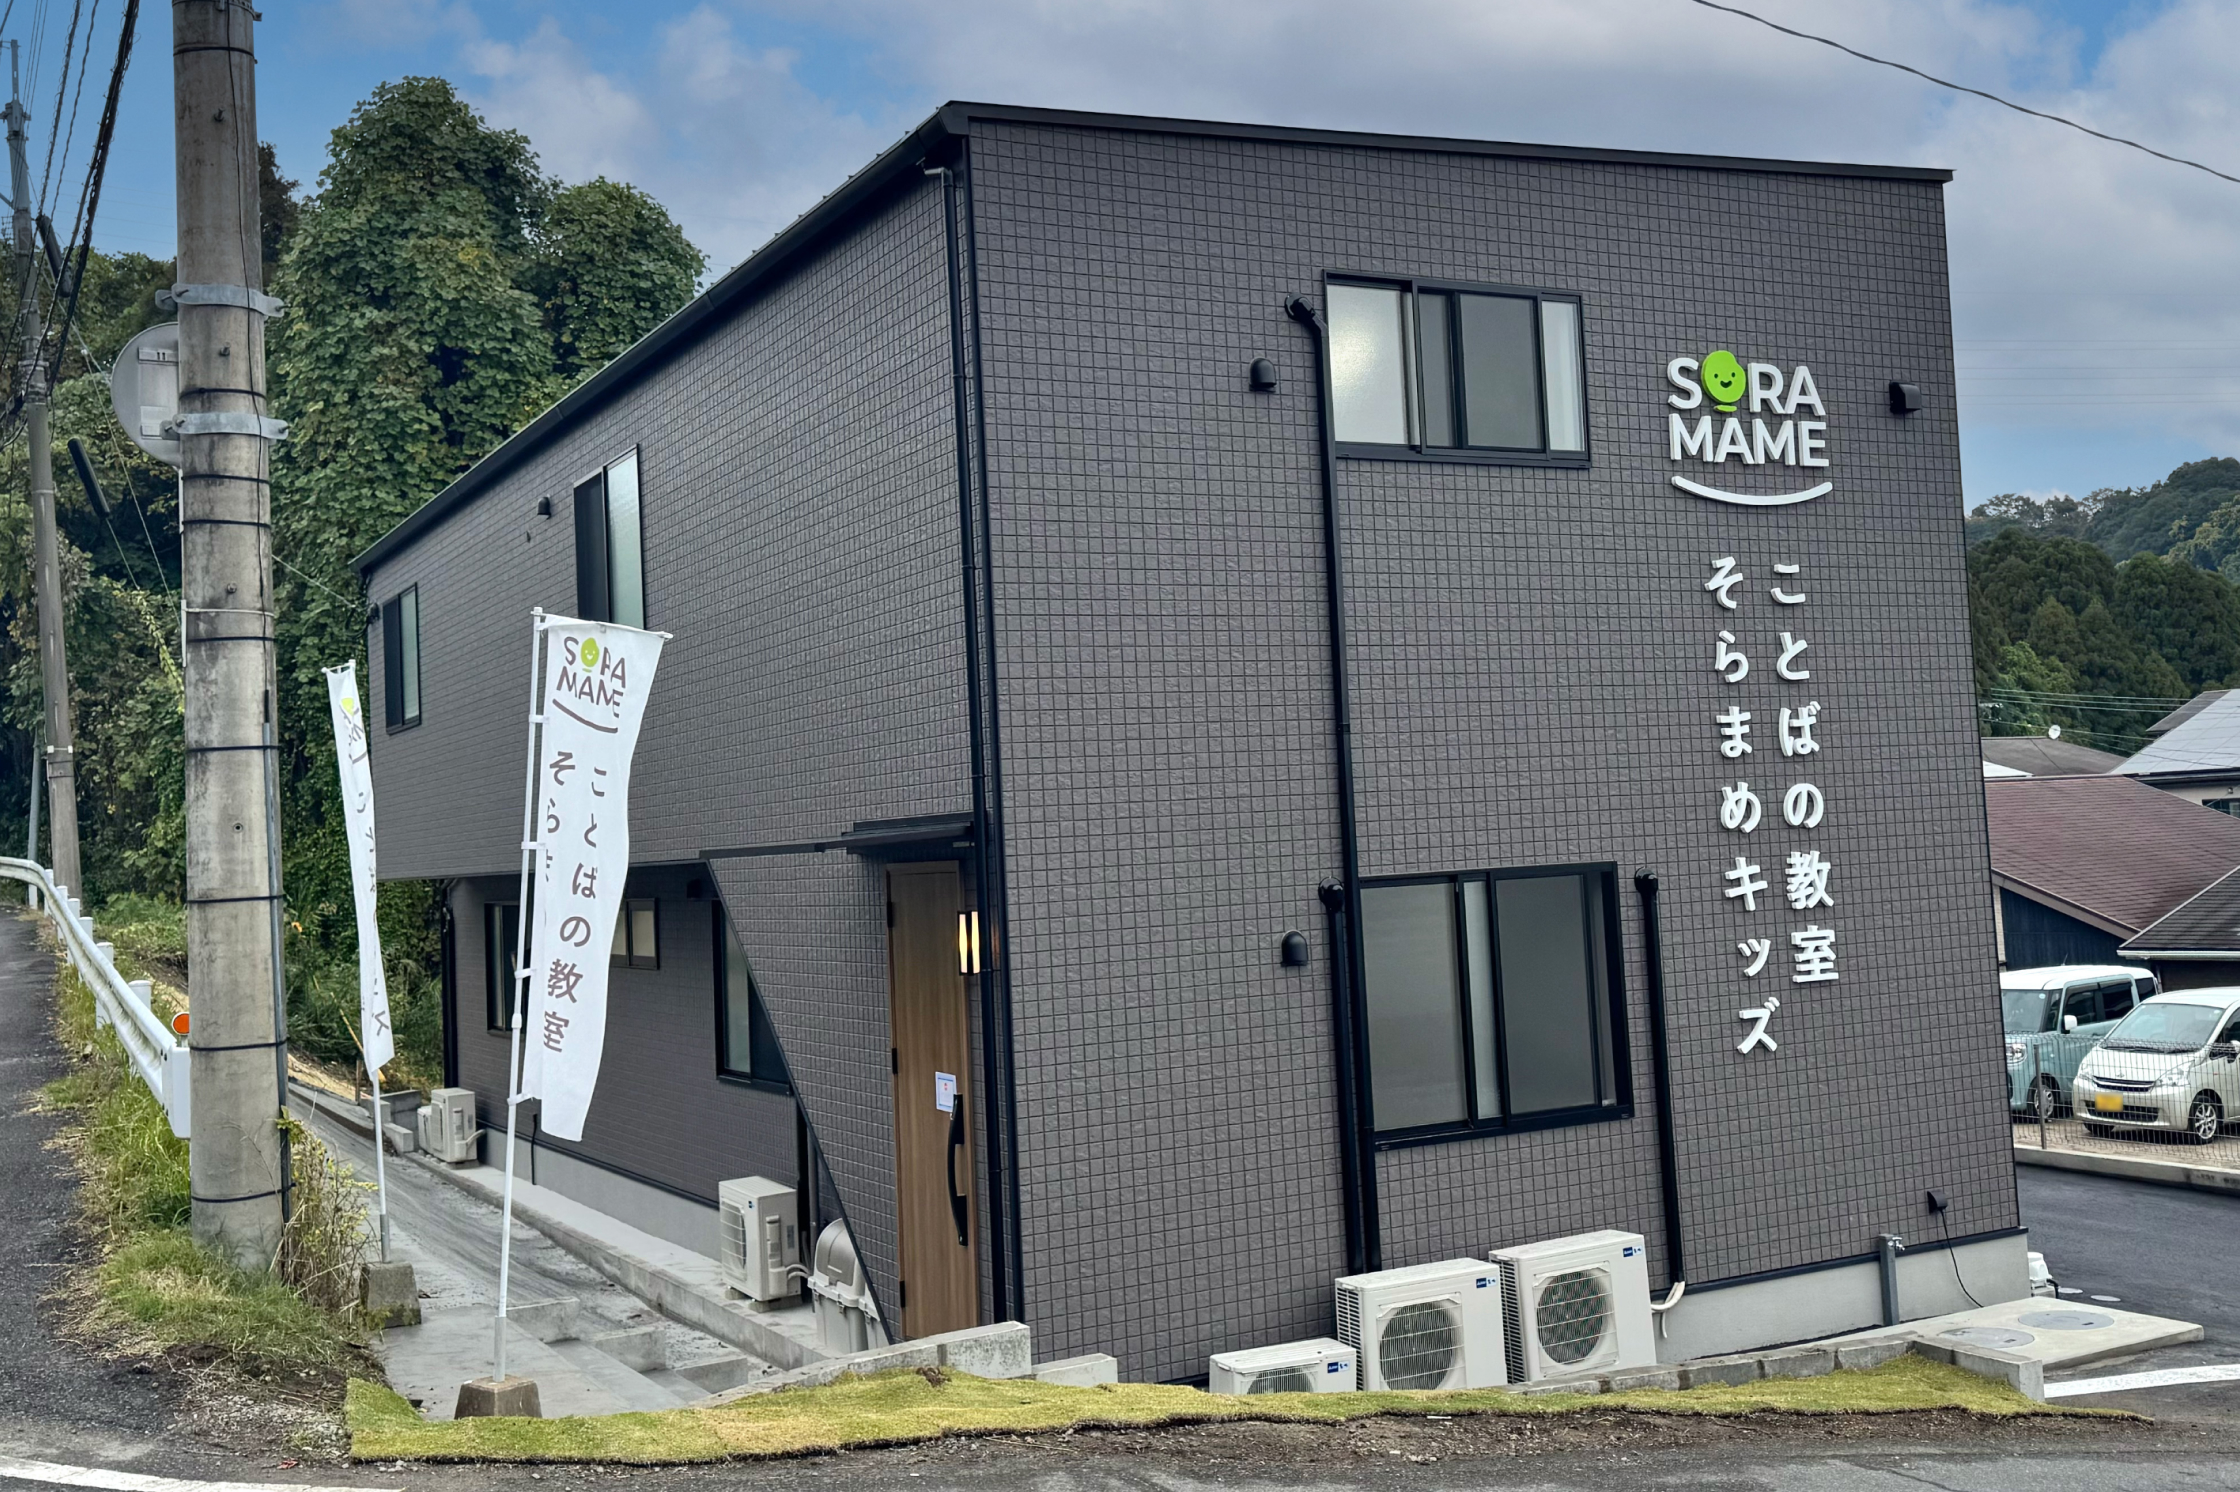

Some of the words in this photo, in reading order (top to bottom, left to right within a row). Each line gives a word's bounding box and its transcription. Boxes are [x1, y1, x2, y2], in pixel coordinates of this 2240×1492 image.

[1667, 350, 1827, 416] SORA
[1668, 413, 1830, 467] MAME
[1704, 556, 1780, 1054] そらまめキッズ
[1770, 563, 1839, 983] ことばの教室
